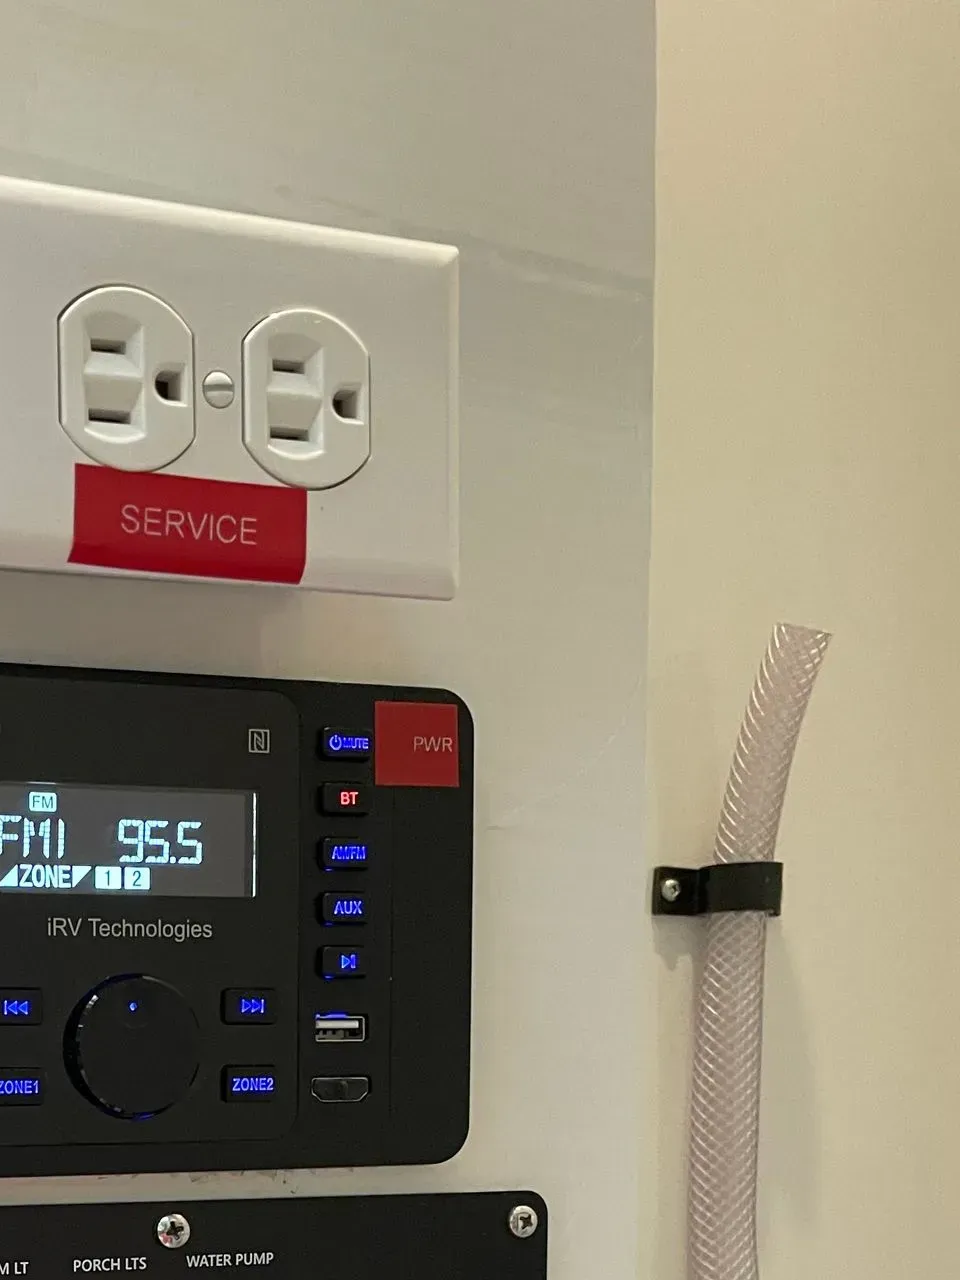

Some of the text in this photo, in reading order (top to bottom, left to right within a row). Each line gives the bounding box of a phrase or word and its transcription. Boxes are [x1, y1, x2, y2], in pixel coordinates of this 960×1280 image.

[120, 504, 258, 546] SERVICE
[343, 737, 369, 749] MUTE
[413, 736, 453, 753] PWR
[31, 795, 54, 809] FM
[340, 791, 359, 805] BT
[117, 819, 202, 864] 95.5
[18, 863, 72, 888] ZONE
[132, 870, 142, 887] 2
[333, 901, 363, 915] AUX
[47, 918, 212, 942] iRV Technologies
[232, 1077, 275, 1092] ZONE2
[14, 1261, 29, 1275] LT
[73, 1256, 147, 1272] PORCH LTS
[186, 1252, 274, 1268] WATER PUMP
